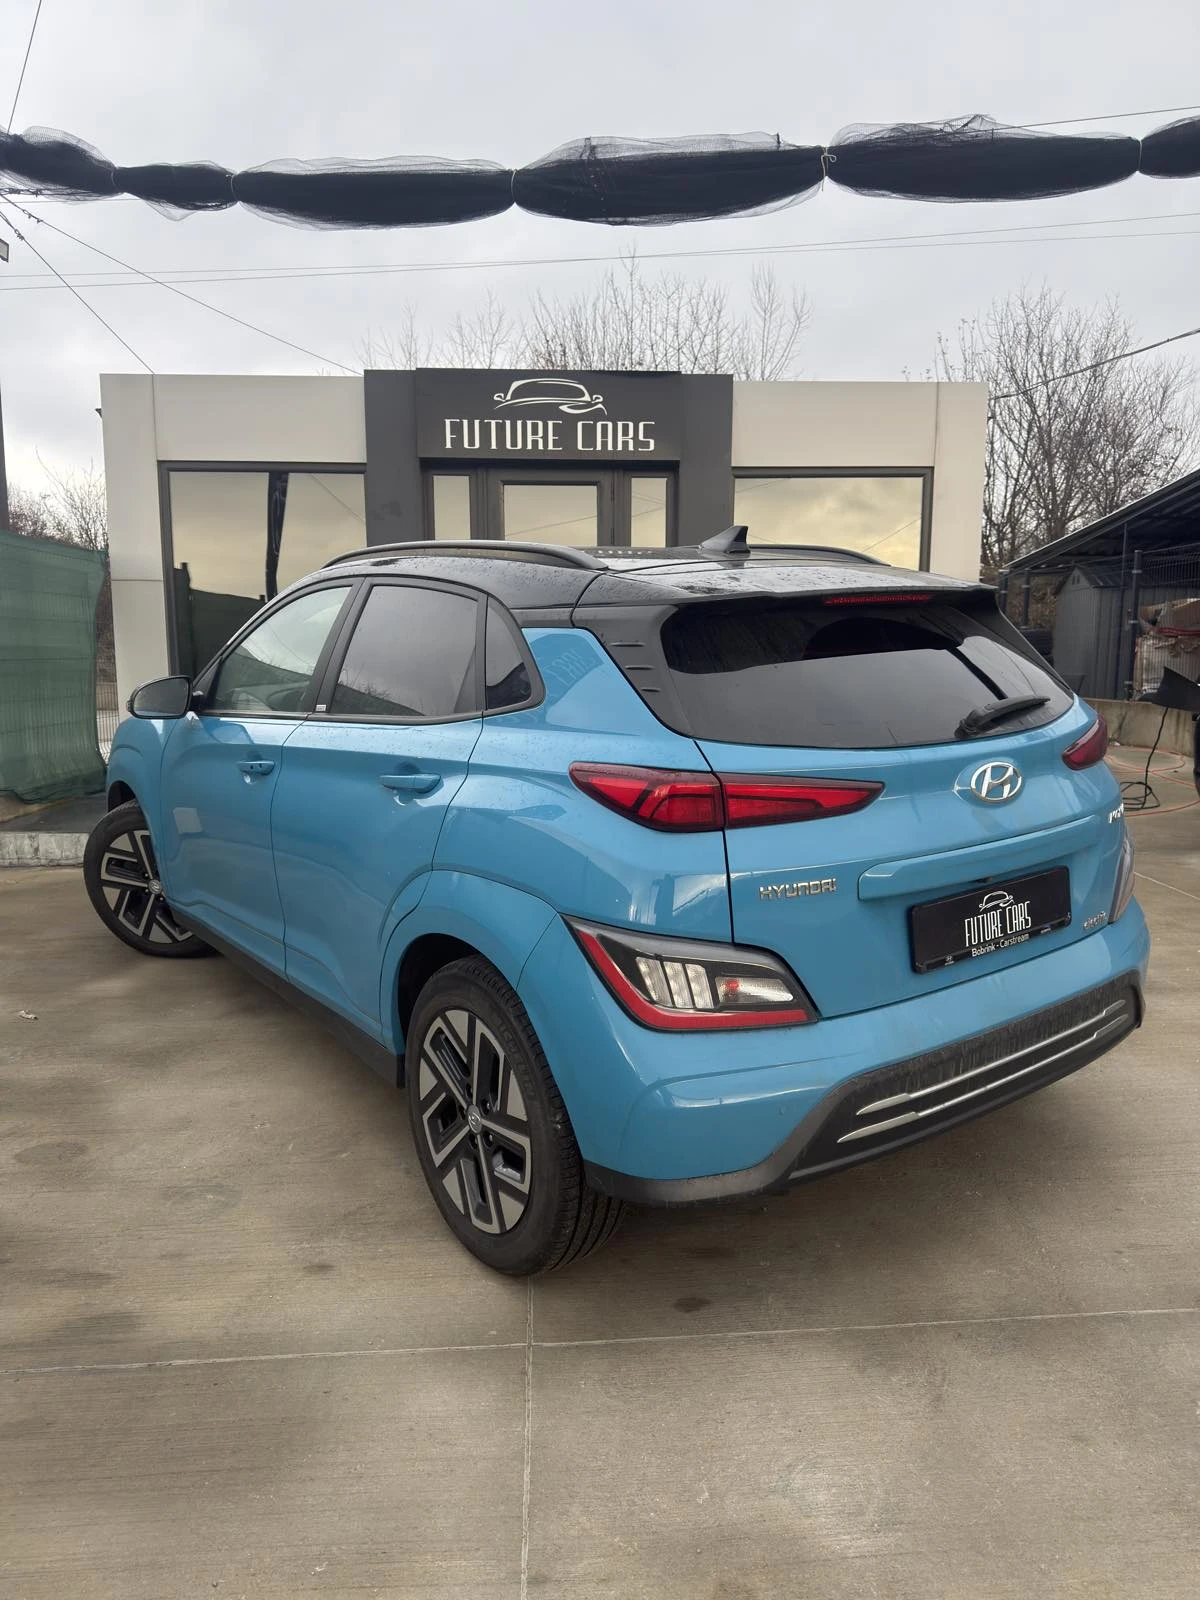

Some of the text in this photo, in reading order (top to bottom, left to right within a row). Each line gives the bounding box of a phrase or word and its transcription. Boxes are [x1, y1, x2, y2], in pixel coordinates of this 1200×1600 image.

[444, 418, 656, 452] FUTURE CARS
[759, 878, 837, 900] HYUNDAI
[964, 900, 1032, 947] FUTURE CARS
[971, 942, 996, 957] Bobrink
